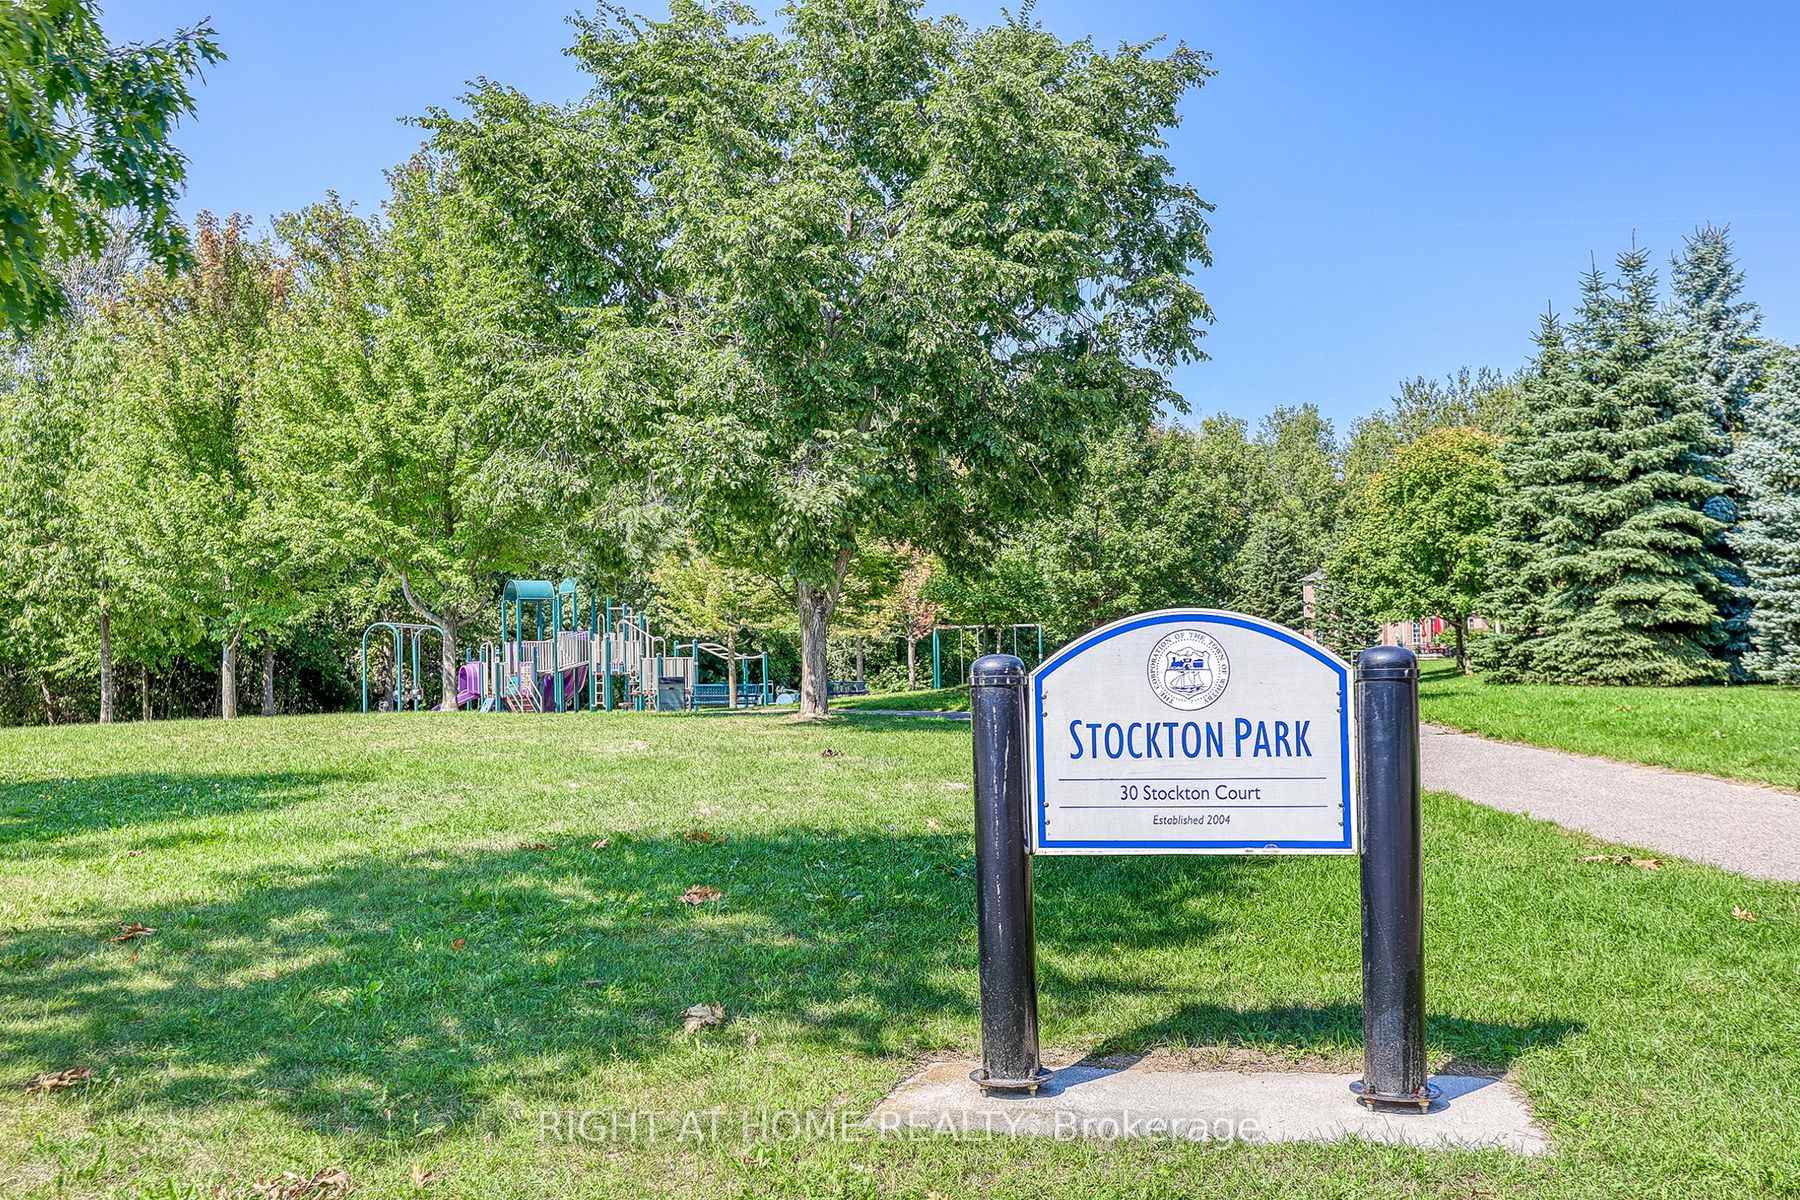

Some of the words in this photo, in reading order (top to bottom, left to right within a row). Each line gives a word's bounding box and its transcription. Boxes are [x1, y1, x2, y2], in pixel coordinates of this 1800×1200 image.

[1174, 632, 1186, 640] OF
[1189, 631, 1206, 642] THE
[1209, 640, 1226, 662] TOWN
[1069, 719, 1224, 759] STOCKTON
[1235, 717, 1312, 757] PARK
[1120, 785, 1138, 801] 30
[1143, 784, 1210, 801] Stockton
[1215, 784, 1261, 801] Court
[1153, 814, 1204, 825] Established
[1207, 814, 1231, 825] 2004
